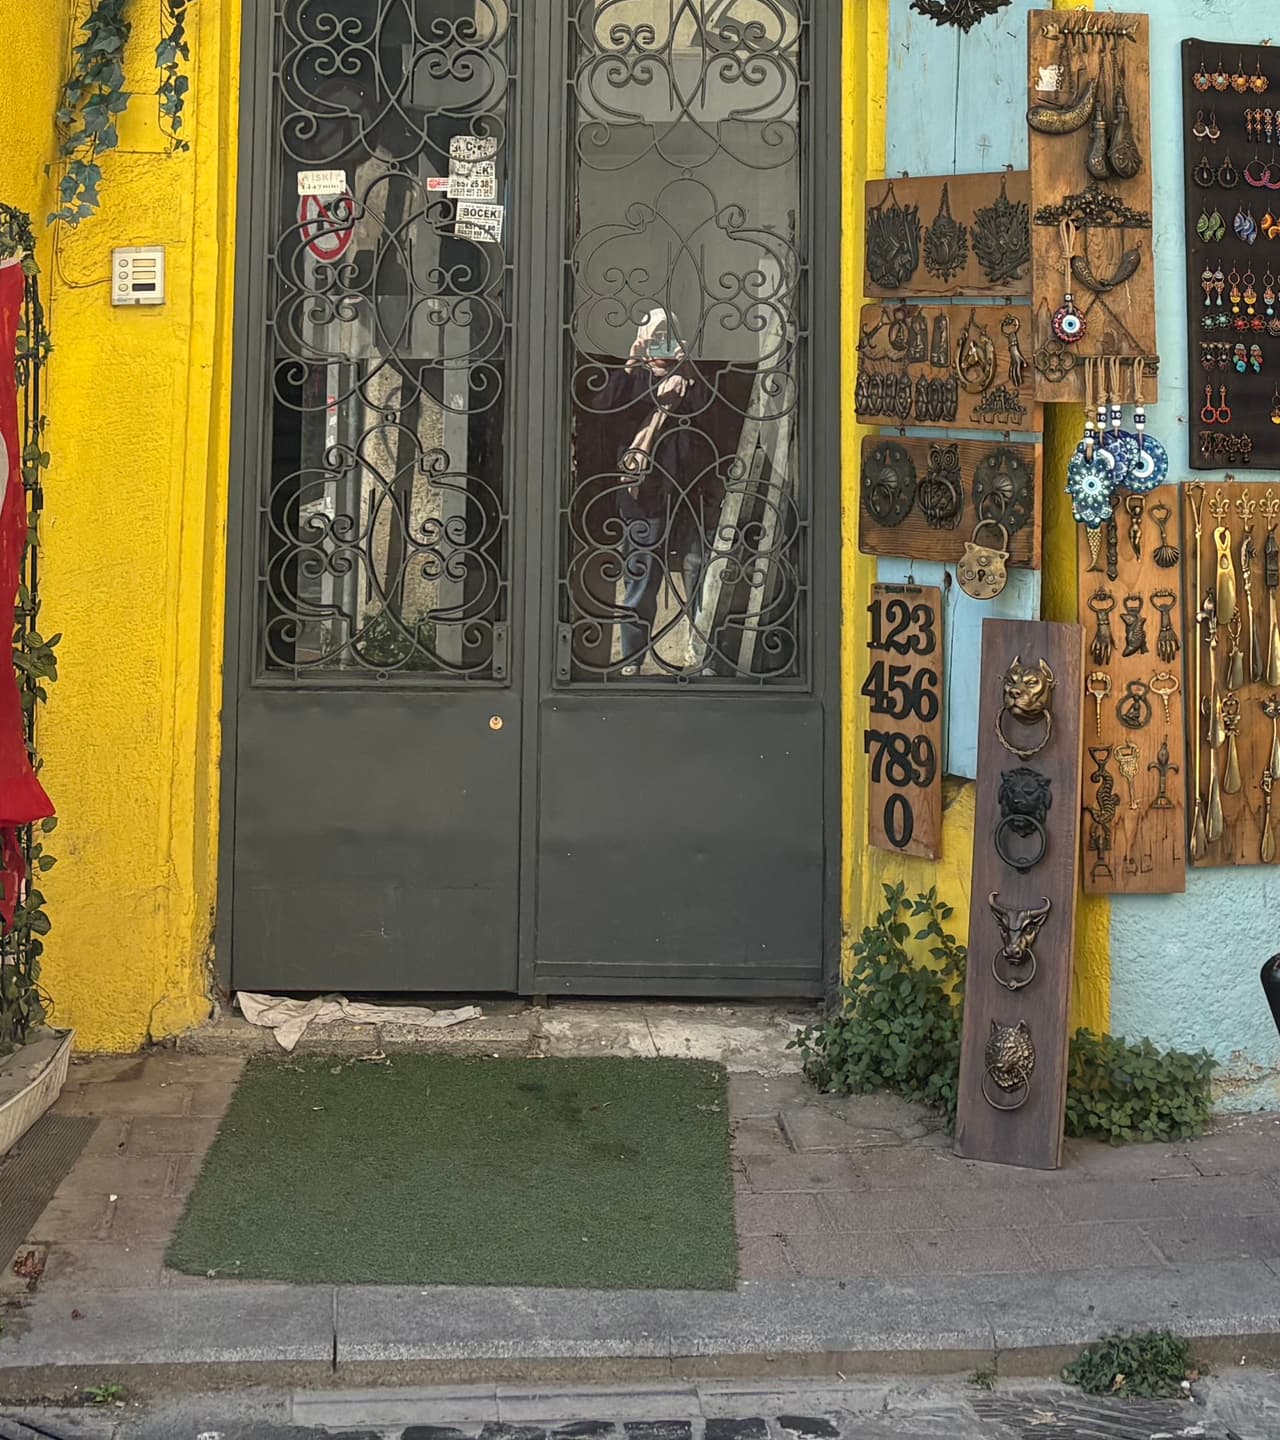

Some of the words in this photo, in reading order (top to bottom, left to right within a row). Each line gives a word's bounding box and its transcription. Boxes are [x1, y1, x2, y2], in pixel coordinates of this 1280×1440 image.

[866, 598, 936, 657] 123
[861, 660, 939, 723] 456
[864, 728, 937, 789] 789
[883, 792, 914, 849] 0
